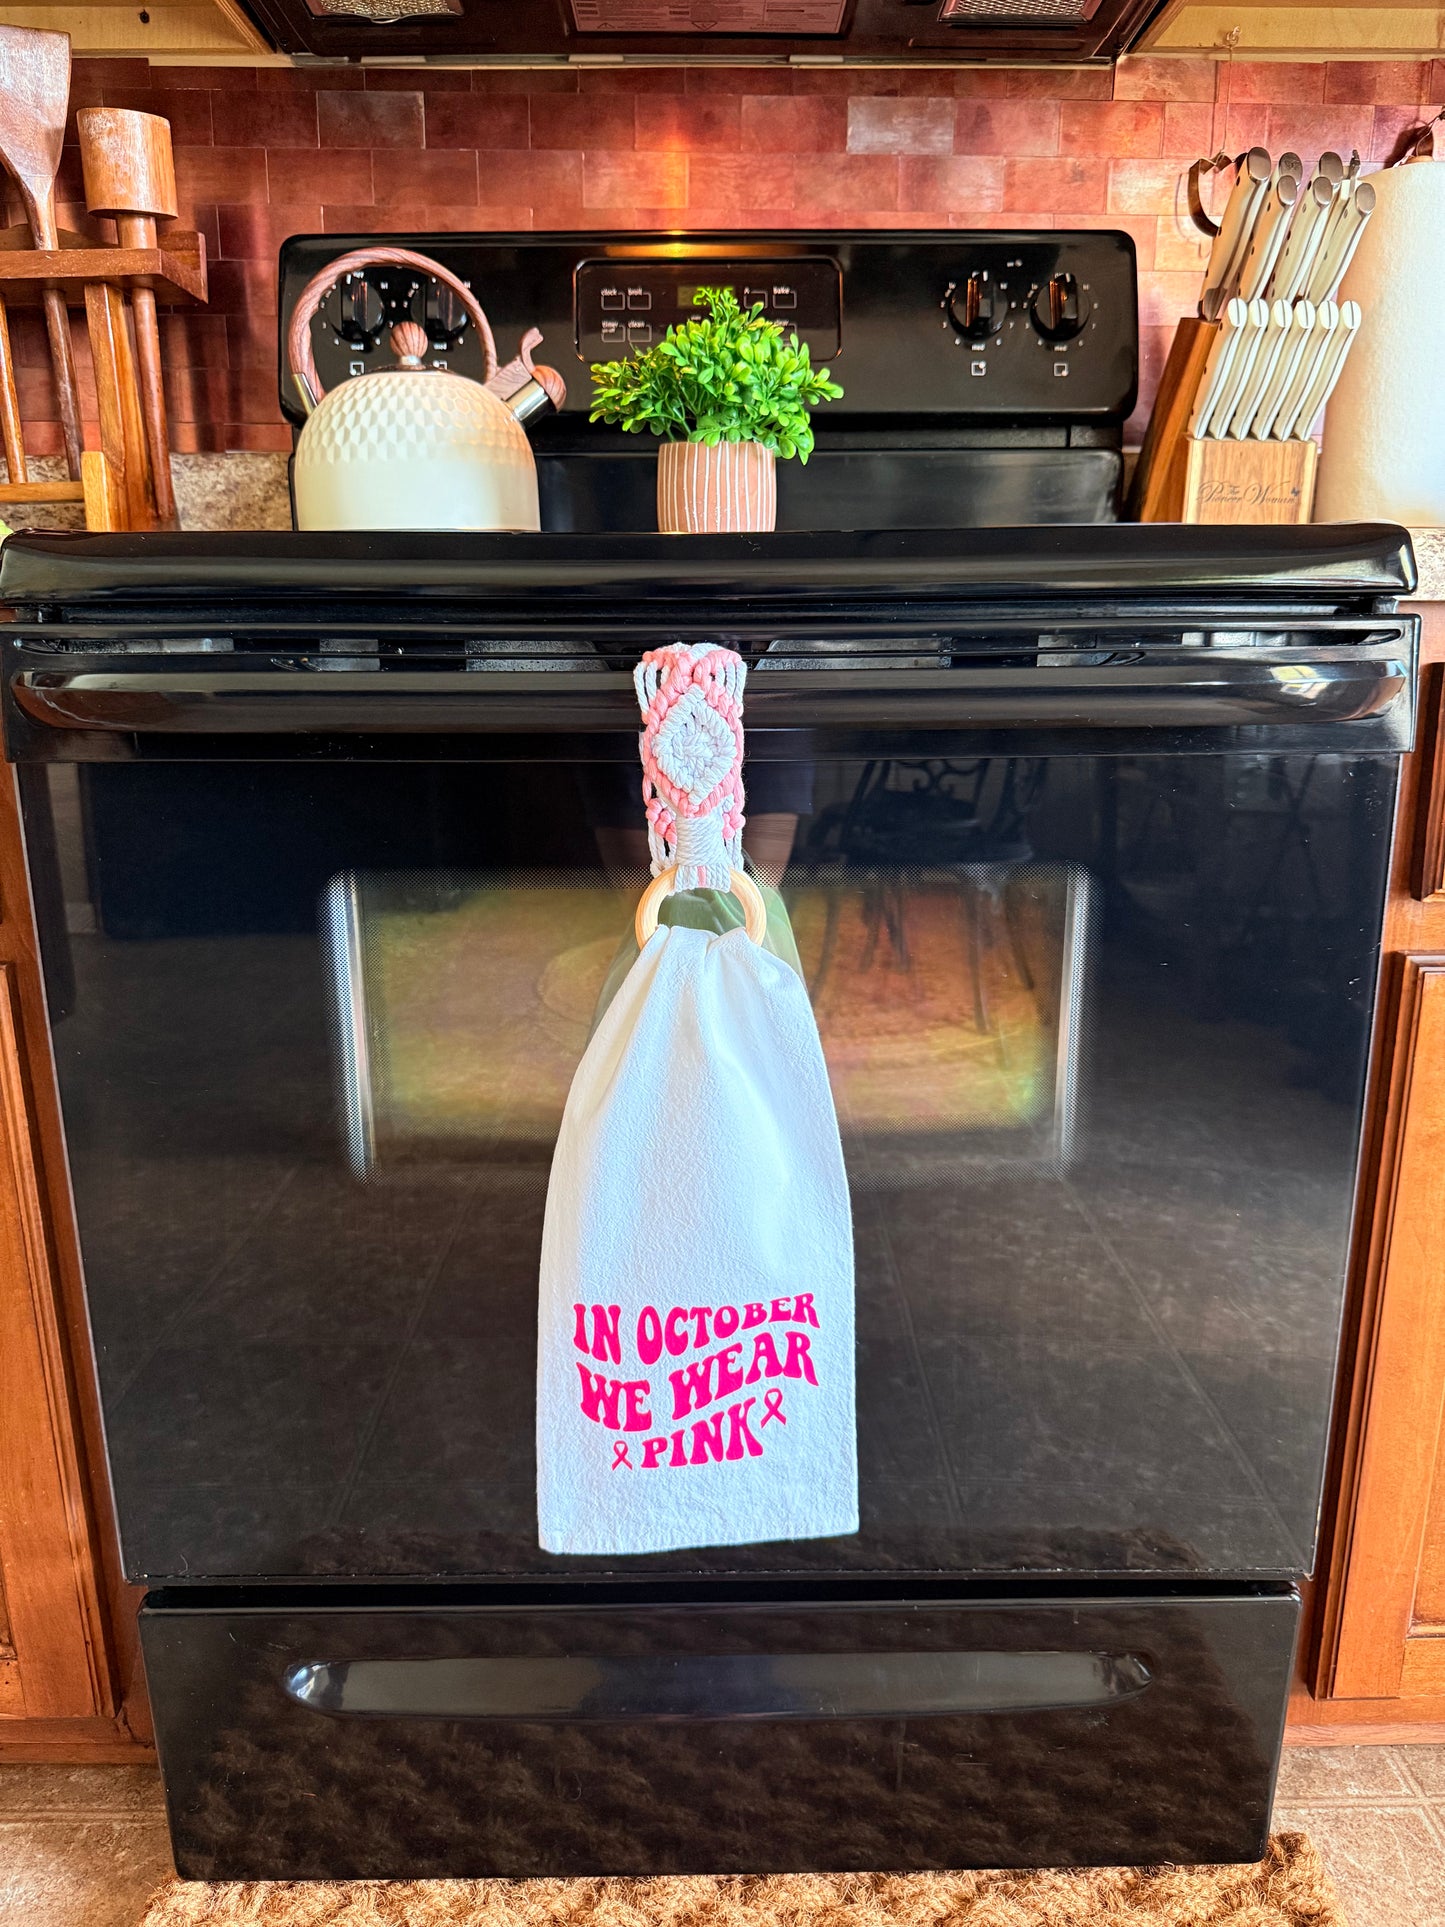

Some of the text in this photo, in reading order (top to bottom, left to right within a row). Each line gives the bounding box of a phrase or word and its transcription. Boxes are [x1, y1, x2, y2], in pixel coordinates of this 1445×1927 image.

[573, 1292, 820, 1366] IN OCTOBER
[576, 1330, 820, 1433] WE WEAR
[640, 1396, 764, 1469] PINK
